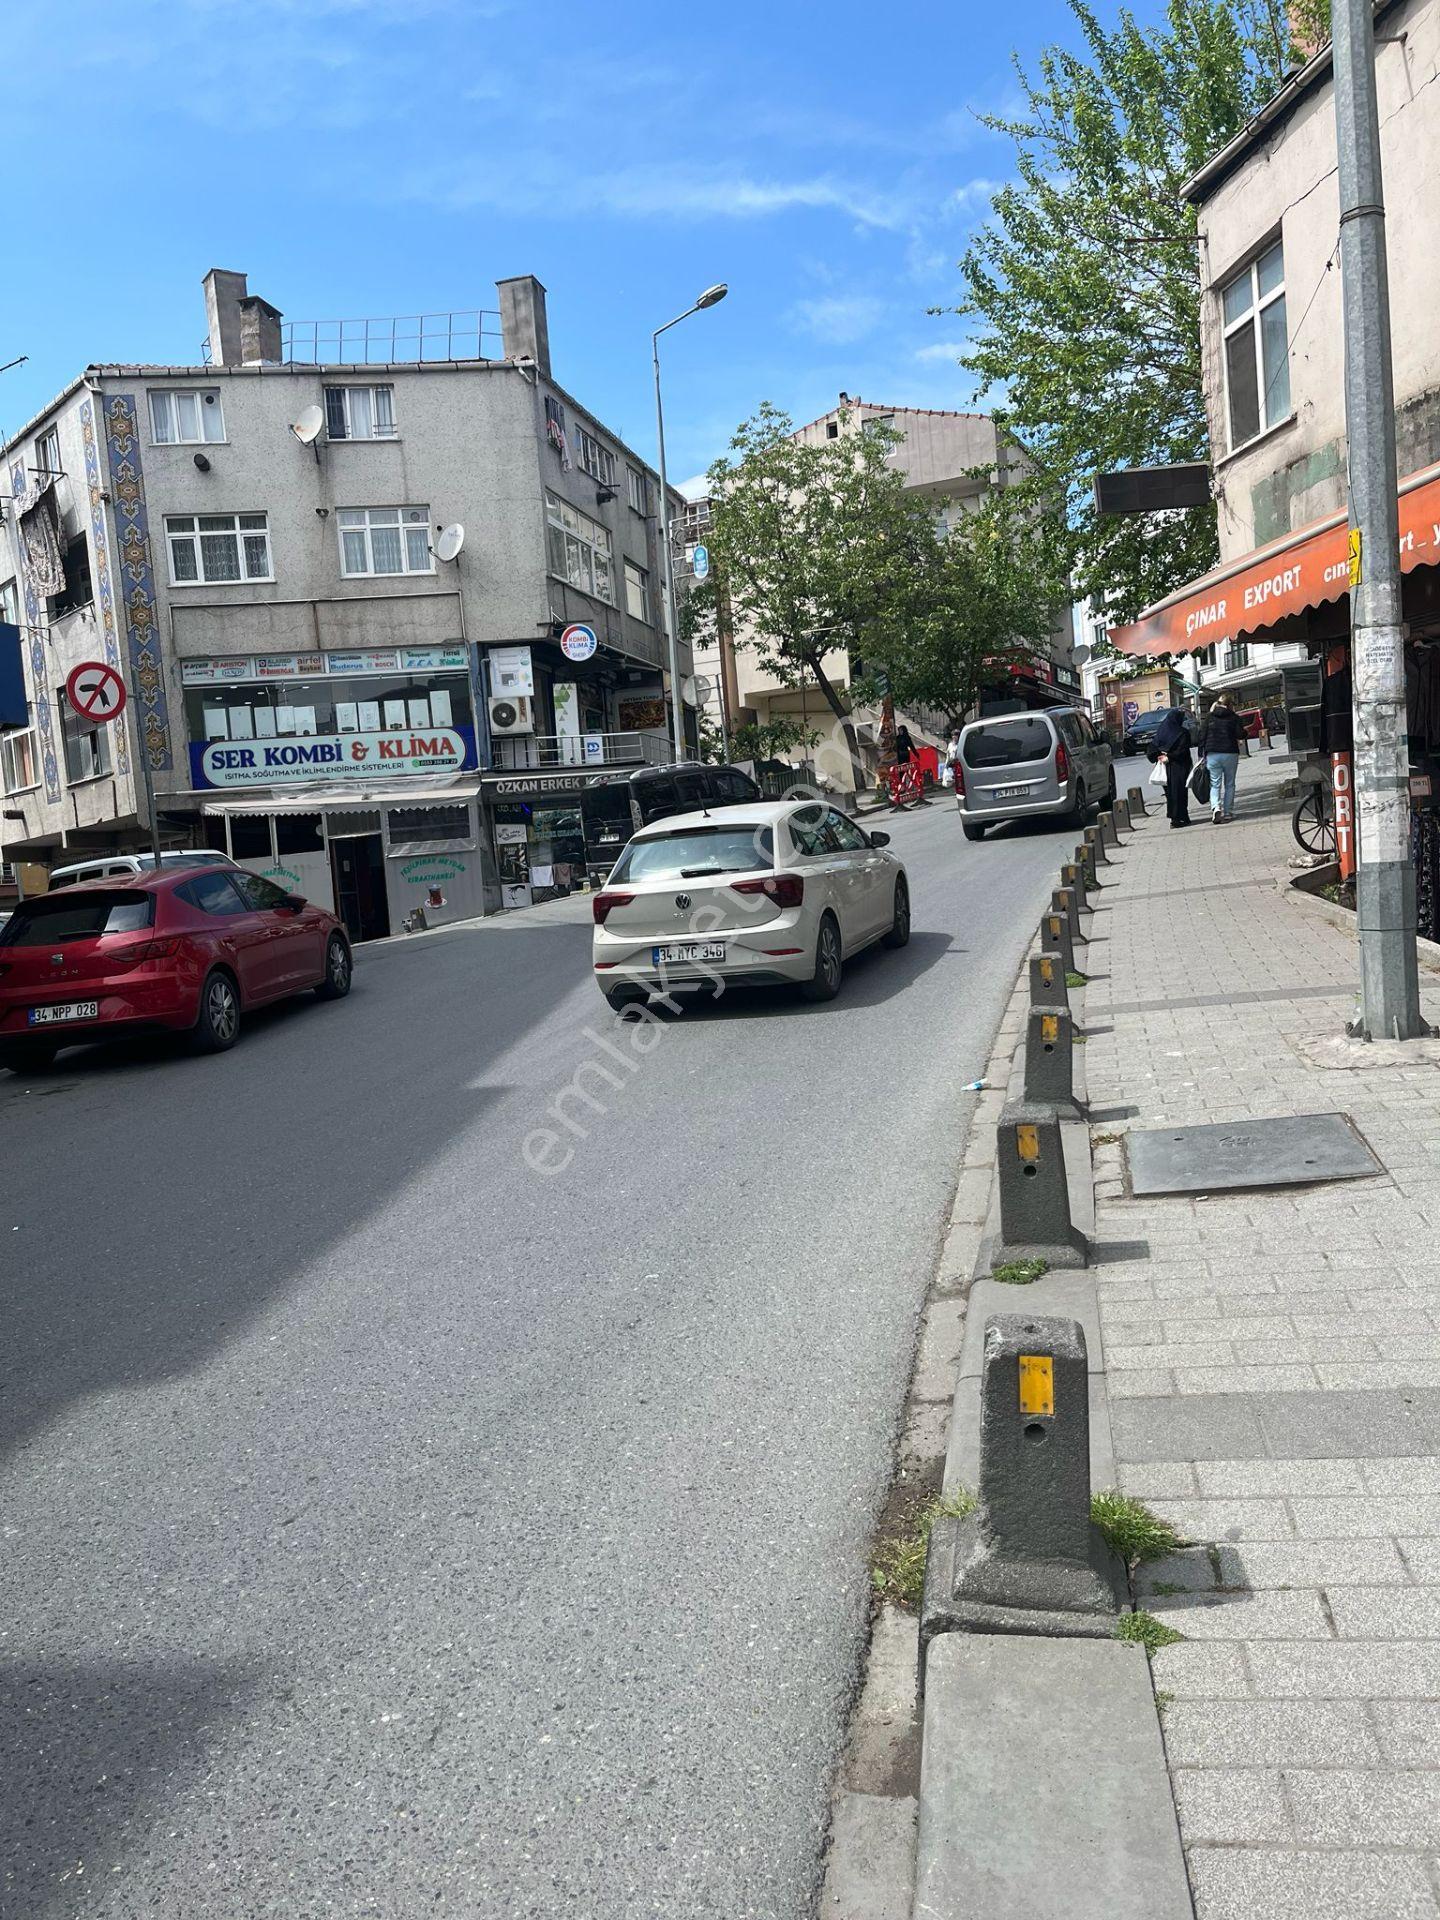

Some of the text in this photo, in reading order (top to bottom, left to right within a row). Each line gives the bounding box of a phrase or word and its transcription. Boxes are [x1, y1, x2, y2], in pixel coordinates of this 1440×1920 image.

[1186, 600, 1227, 638] ÇINAR
[1244, 565, 1302, 610] EXPORT
[297, 655, 321, 665] airfel
[211, 733, 456, 770] SER KOMBİ & KLİMA
[253, 769, 289, 778] SOĞUTMA
[302, 764, 360, 775] İKLİMLENDİRME
[362, 762, 404, 771] SİSTEMLERİ
[496, 781, 538, 794] ÖZKAN
[540, 778, 580, 791] ERKEK
[438, 856, 465, 872] MEYDAN
[408, 870, 456, 883] KIRAATHANESİ
[659, 949, 672, 961] 34
[703, 944, 722, 958] 346
[40, 969, 80, 979] LEON
[35, 1003, 96, 1021] 34 NPP 028
